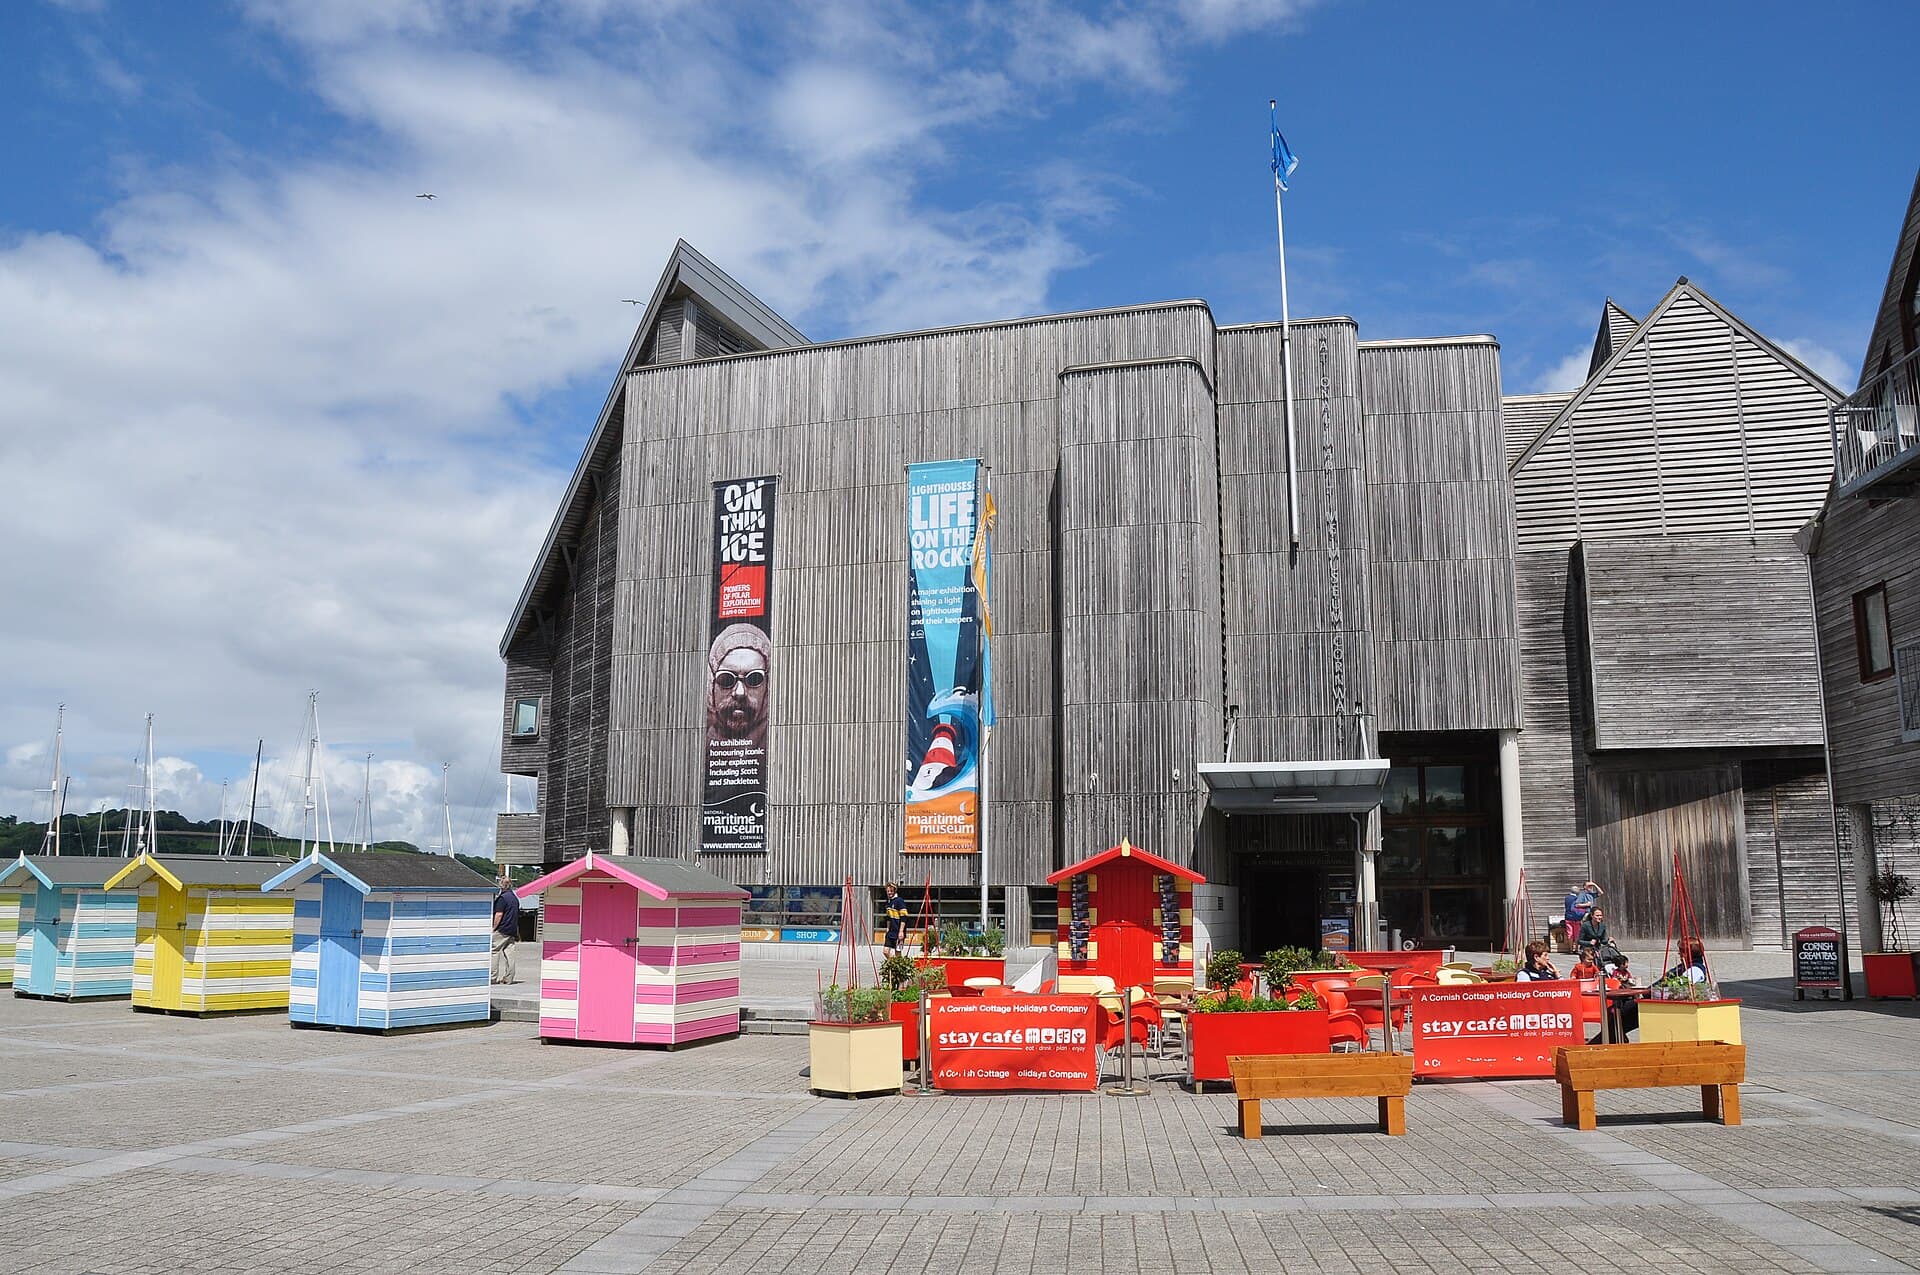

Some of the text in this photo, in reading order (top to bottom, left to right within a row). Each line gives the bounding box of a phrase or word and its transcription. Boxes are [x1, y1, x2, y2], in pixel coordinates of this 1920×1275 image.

[911, 481, 975, 495] LIGHTHOUSES:
[724, 480, 765, 512] ON
[911, 492, 975, 530] LIFE
[720, 511, 766, 533] THIN
[911, 530, 939, 549] ON
[721, 532, 766, 562] ICE
[732, 591, 750, 599] POLAR
[918, 588, 938, 597] major
[939, 585, 975, 595] exhibition
[723, 598, 760, 607] EXPLORATION
[911, 598, 937, 607] shining
[943, 596, 961, 606] light
[921, 606, 962, 616] lighthouses
[925, 617, 943, 625] their
[944, 616, 973, 625] keepers
[720, 738, 753, 746] exhibition
[710, 747, 765, 757] honouring iconic
[710, 758, 727, 767] polar
[740, 767, 758, 775] Scott
[709, 777, 760, 786] and Shackleton.
[703, 812, 756, 825] maritime
[908, 812, 966, 825] maritime
[714, 824, 764, 834] museum
[920, 824, 975, 834] museum
[703, 841, 762, 849] www.nmmc.co.uk
[908, 842, 974, 850] www.nmmc.co.uk
[796, 931, 818, 939] SHOP
[1802, 942, 1834, 951] CORNISH
[1798, 951, 1838, 960] CREAM TEAS
[1421, 990, 1572, 1002] A Cornish Cottage Holidays Company
[939, 1003, 1089, 1014] A Cornish Cottage Holidays Company
[1422, 1016, 1508, 1036] stay café
[939, 1028, 1023, 1047] stay café
[1541, 1030, 1554, 1038] plan
[1558, 1030, 1573, 1039] enjoy
[1056, 1045, 1068, 1053] plan
[1071, 1045, 1086, 1053] enjoy
[977, 1069, 1010, 1079] Cottage
[1018, 1069, 1047, 1079] olidays
[1049, 1069, 1088, 1079] Company
